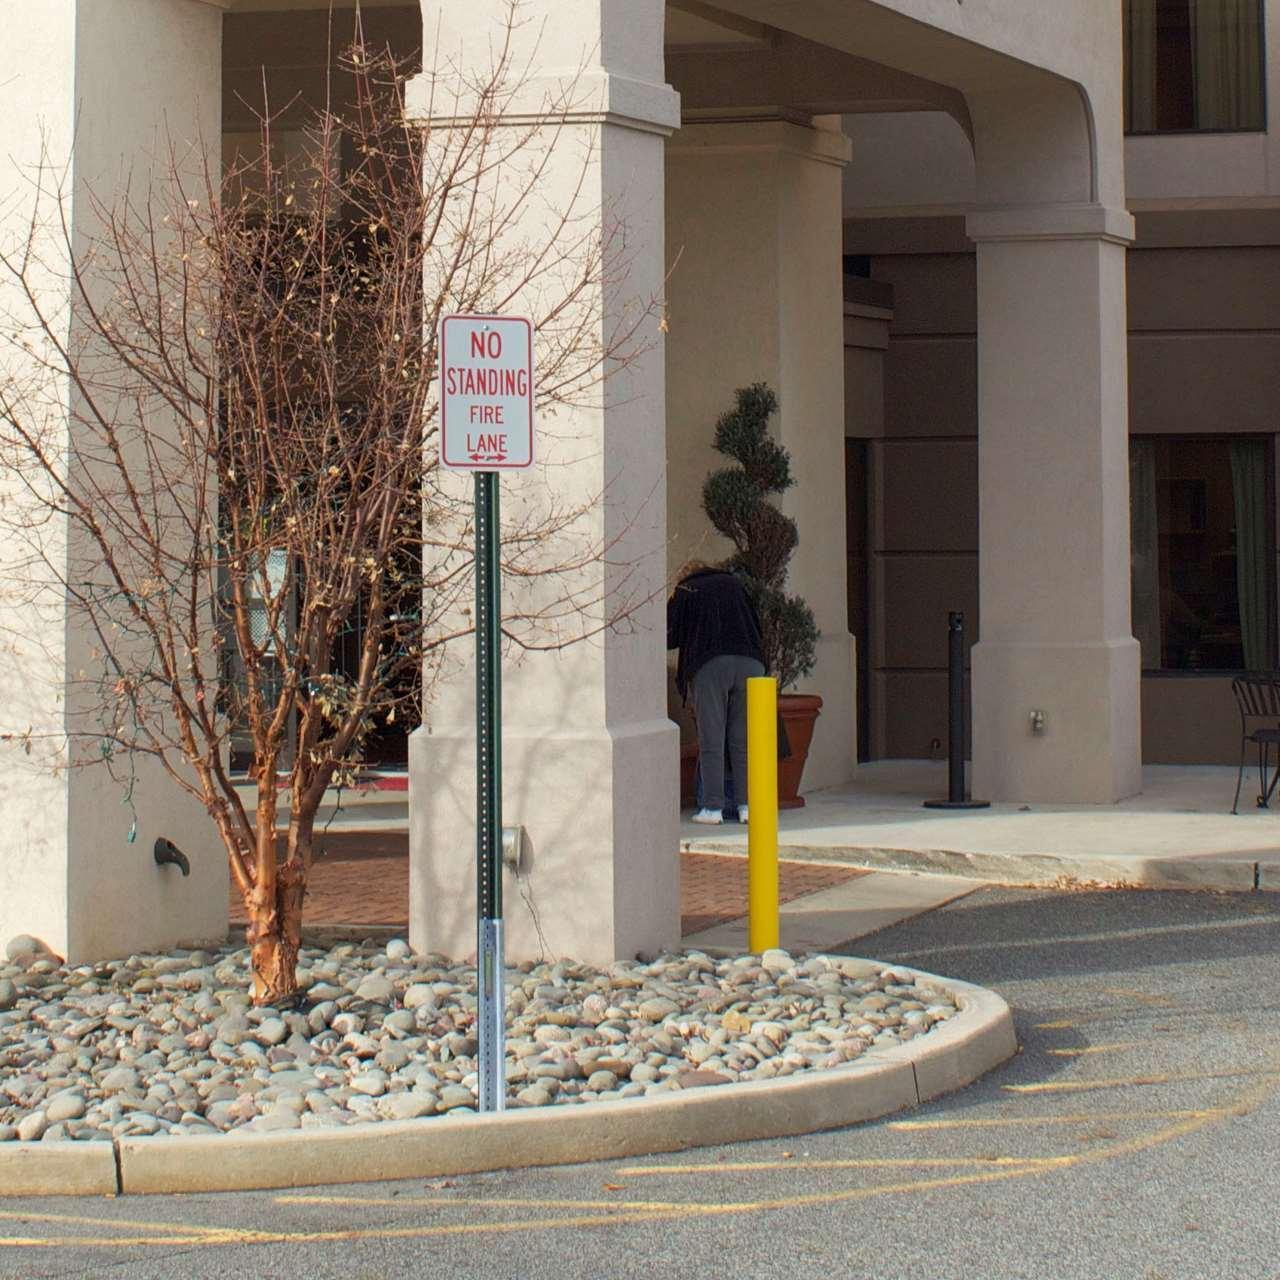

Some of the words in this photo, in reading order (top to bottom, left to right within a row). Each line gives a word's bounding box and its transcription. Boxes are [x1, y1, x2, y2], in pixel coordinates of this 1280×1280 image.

[470, 330, 502, 360] NO
[446, 367, 528, 397] STANDING
[469, 405, 505, 425] FIRE
[466, 433, 508, 453] LANE
